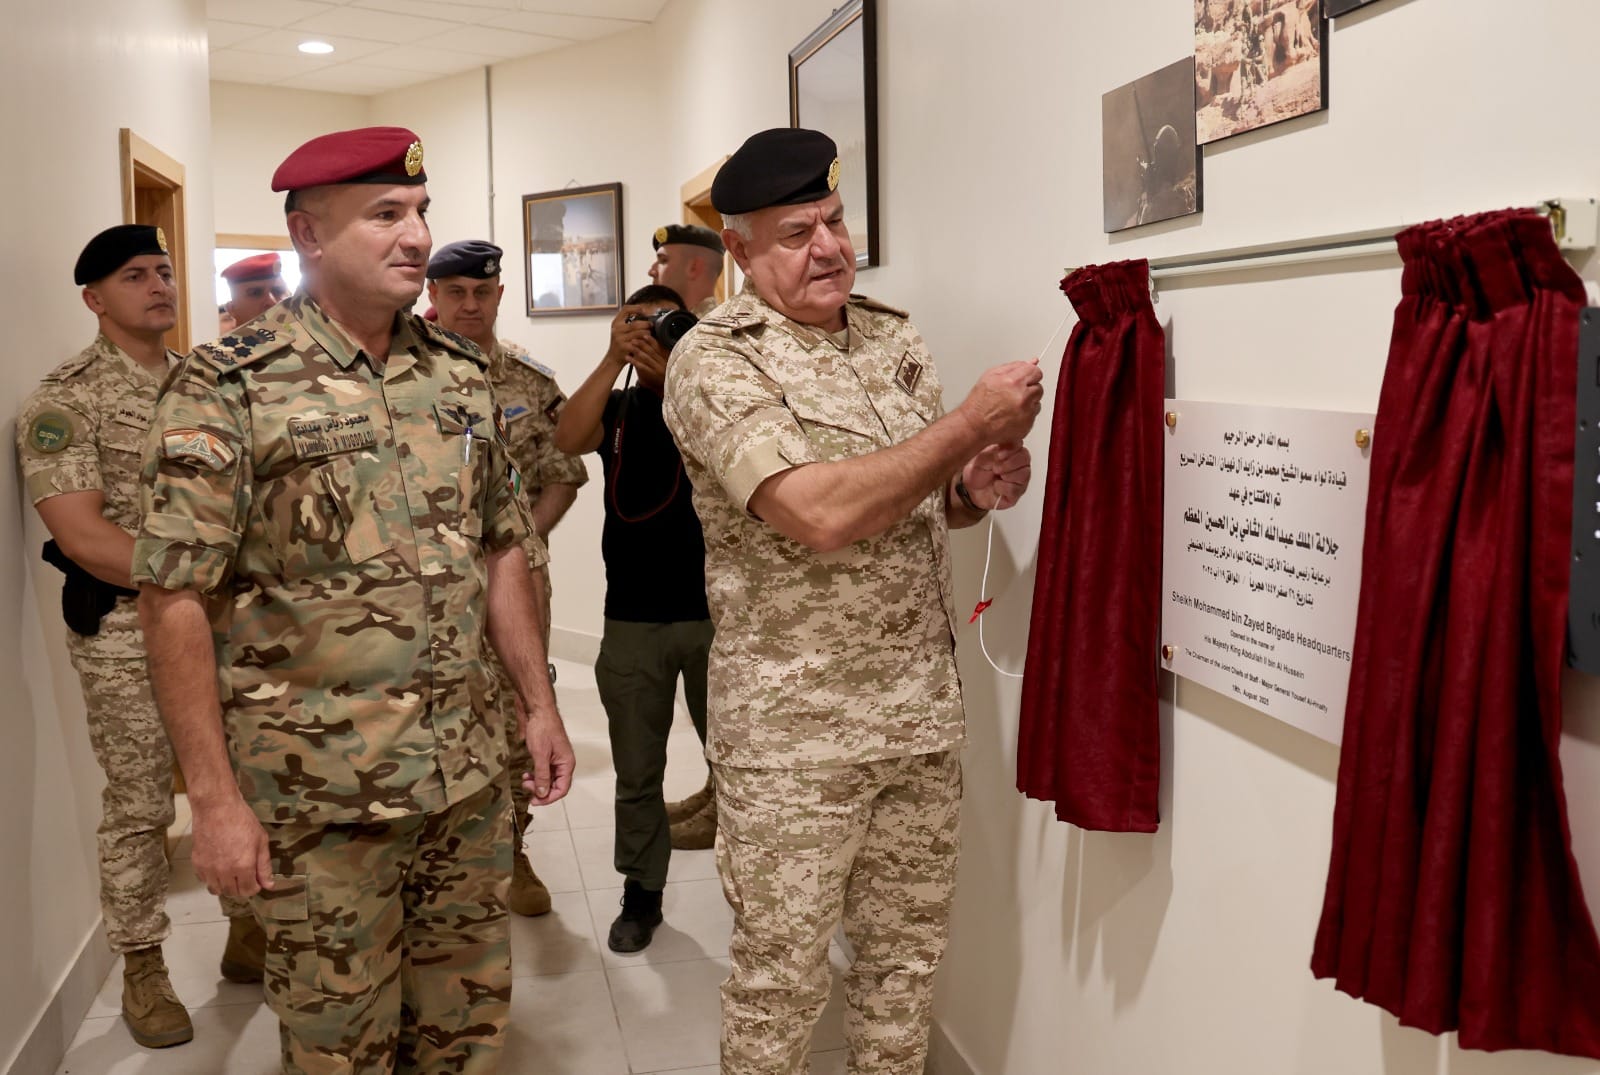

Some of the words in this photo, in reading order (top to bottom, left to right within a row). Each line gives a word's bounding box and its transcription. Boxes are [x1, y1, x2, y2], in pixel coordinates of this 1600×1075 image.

[1224, 429, 1243, 446] الرحيم
[1243, 430, 1265, 448] الرحمن
[1266, 431, 1277, 446] الله
[1277, 437, 1290, 453] بسم
[1255, 461, 1264, 478] بن
[1264, 464, 1280, 476] محمد
[1281, 463, 1299, 483] الشيخ
[1299, 471, 1312, 484] سمو
[1328, 470, 1347, 490] قيادة
[1241, 486, 1248, 506] في
[1274, 491, 1281, 509] تم
[1184, 507, 1203, 524] المعظم
[1205, 511, 1229, 532] الحسين
[1229, 517, 1239, 537] بن
[1240, 517, 1263, 542] الثاني
[1296, 530, 1314, 550] الملك
[1316, 531, 1339, 560] جلالة
[1172, 590, 1193, 608] Sheikh
[1193, 597, 1230, 621] Mohammed
[1231, 610, 1242, 624] bin
[1243, 613, 1265, 632] Zayed
[1266, 621, 1295, 642] Brigade
[1296, 631, 1351, 662] Headquarters
[1212, 637, 1230, 652] Majesty
[1230, 644, 1241, 657] King
[1242, 648, 1263, 663] Abdullah
[1283, 663, 1305, 679] Hussein
